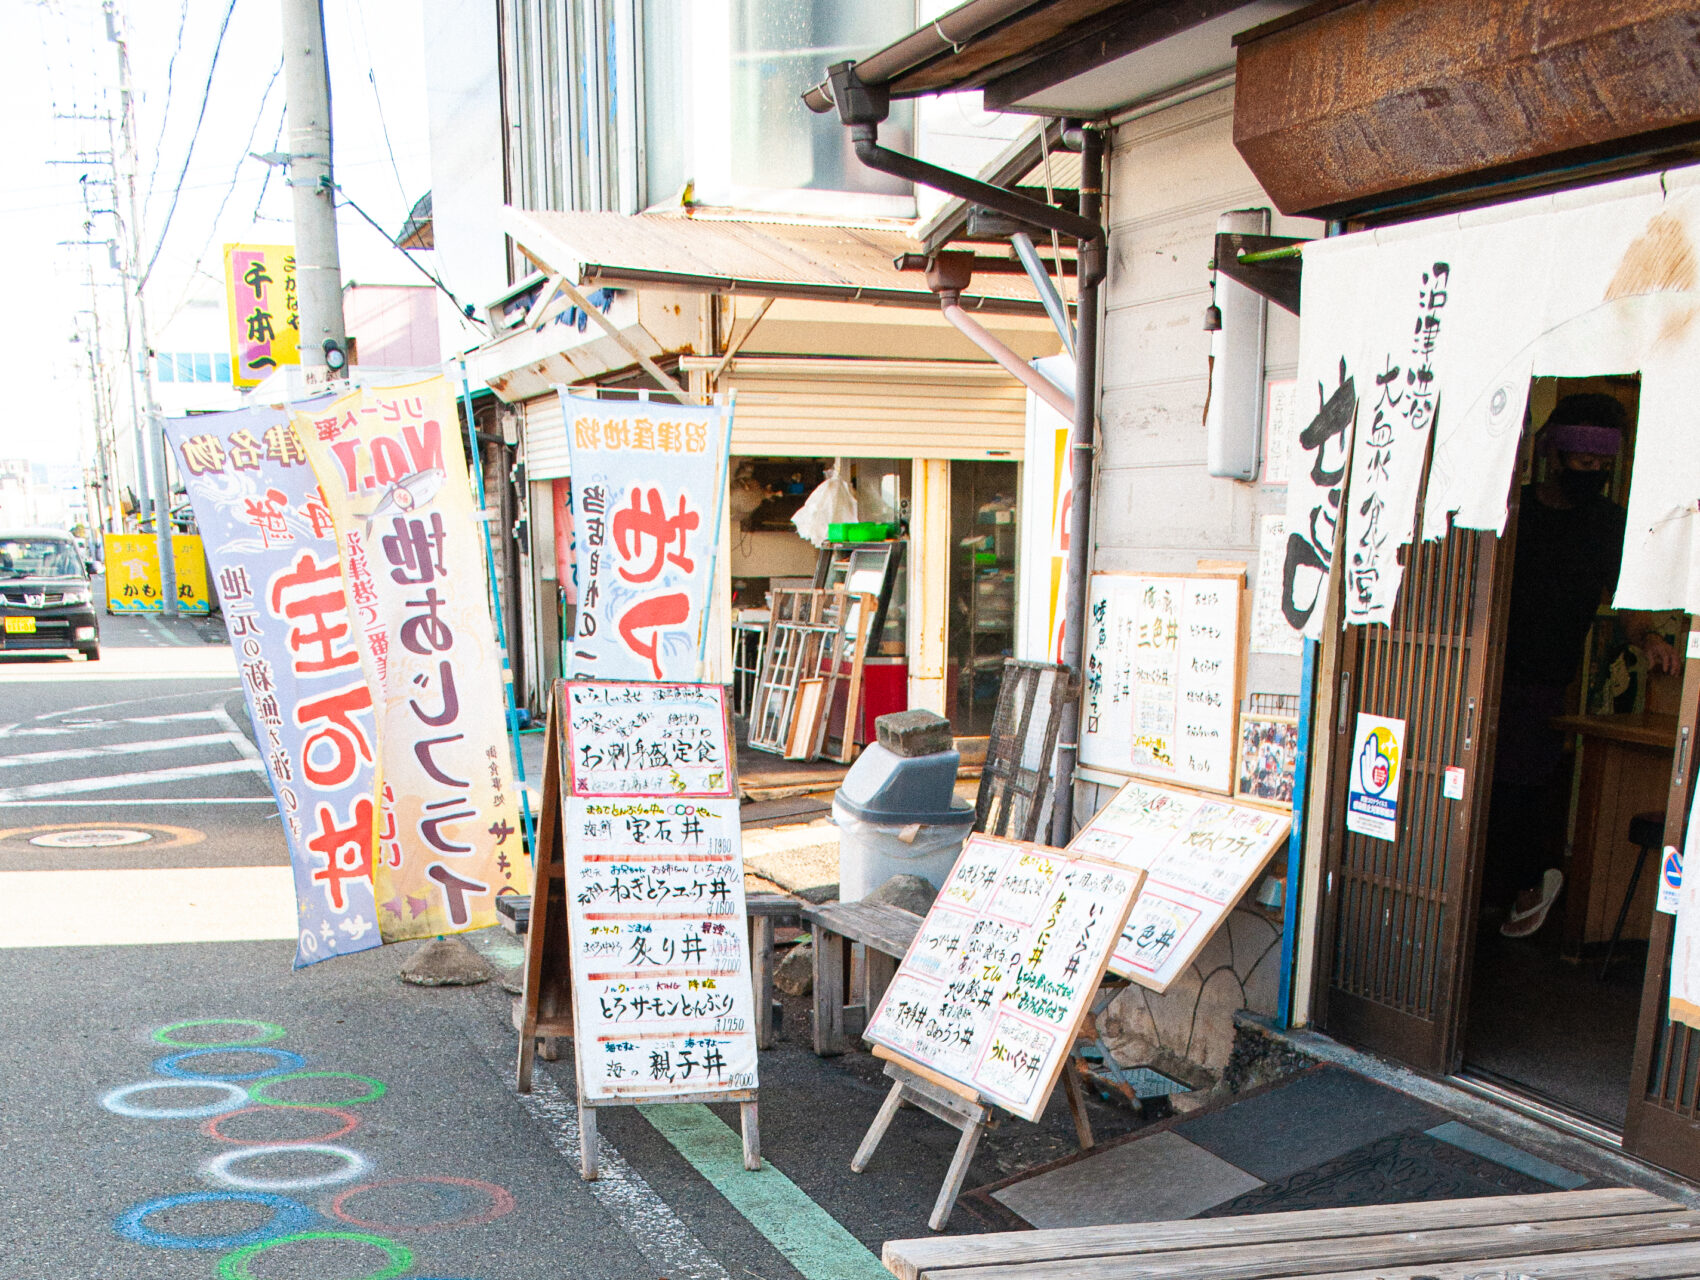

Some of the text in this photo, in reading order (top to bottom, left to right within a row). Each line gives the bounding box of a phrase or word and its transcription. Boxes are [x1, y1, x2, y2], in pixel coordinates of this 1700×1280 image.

[244, 262, 277, 369] 千本一
[1402, 261, 1450, 430] 沼津港
[123, 583, 195, 598] かも丸
[1137, 615, 1179, 651] 三色丼
[580, 738, 720, 770] お刺身盛定食
[626, 815, 705, 848] 宝石丼
[627, 932, 707, 966] 炙り丼
[1026, 891, 1068, 972] 生うに丼
[1062, 903, 1104, 982] いくら丼
[599, 993, 735, 1023] とろサーモンどんぶり
[648, 1047, 728, 1084] 親子丼
